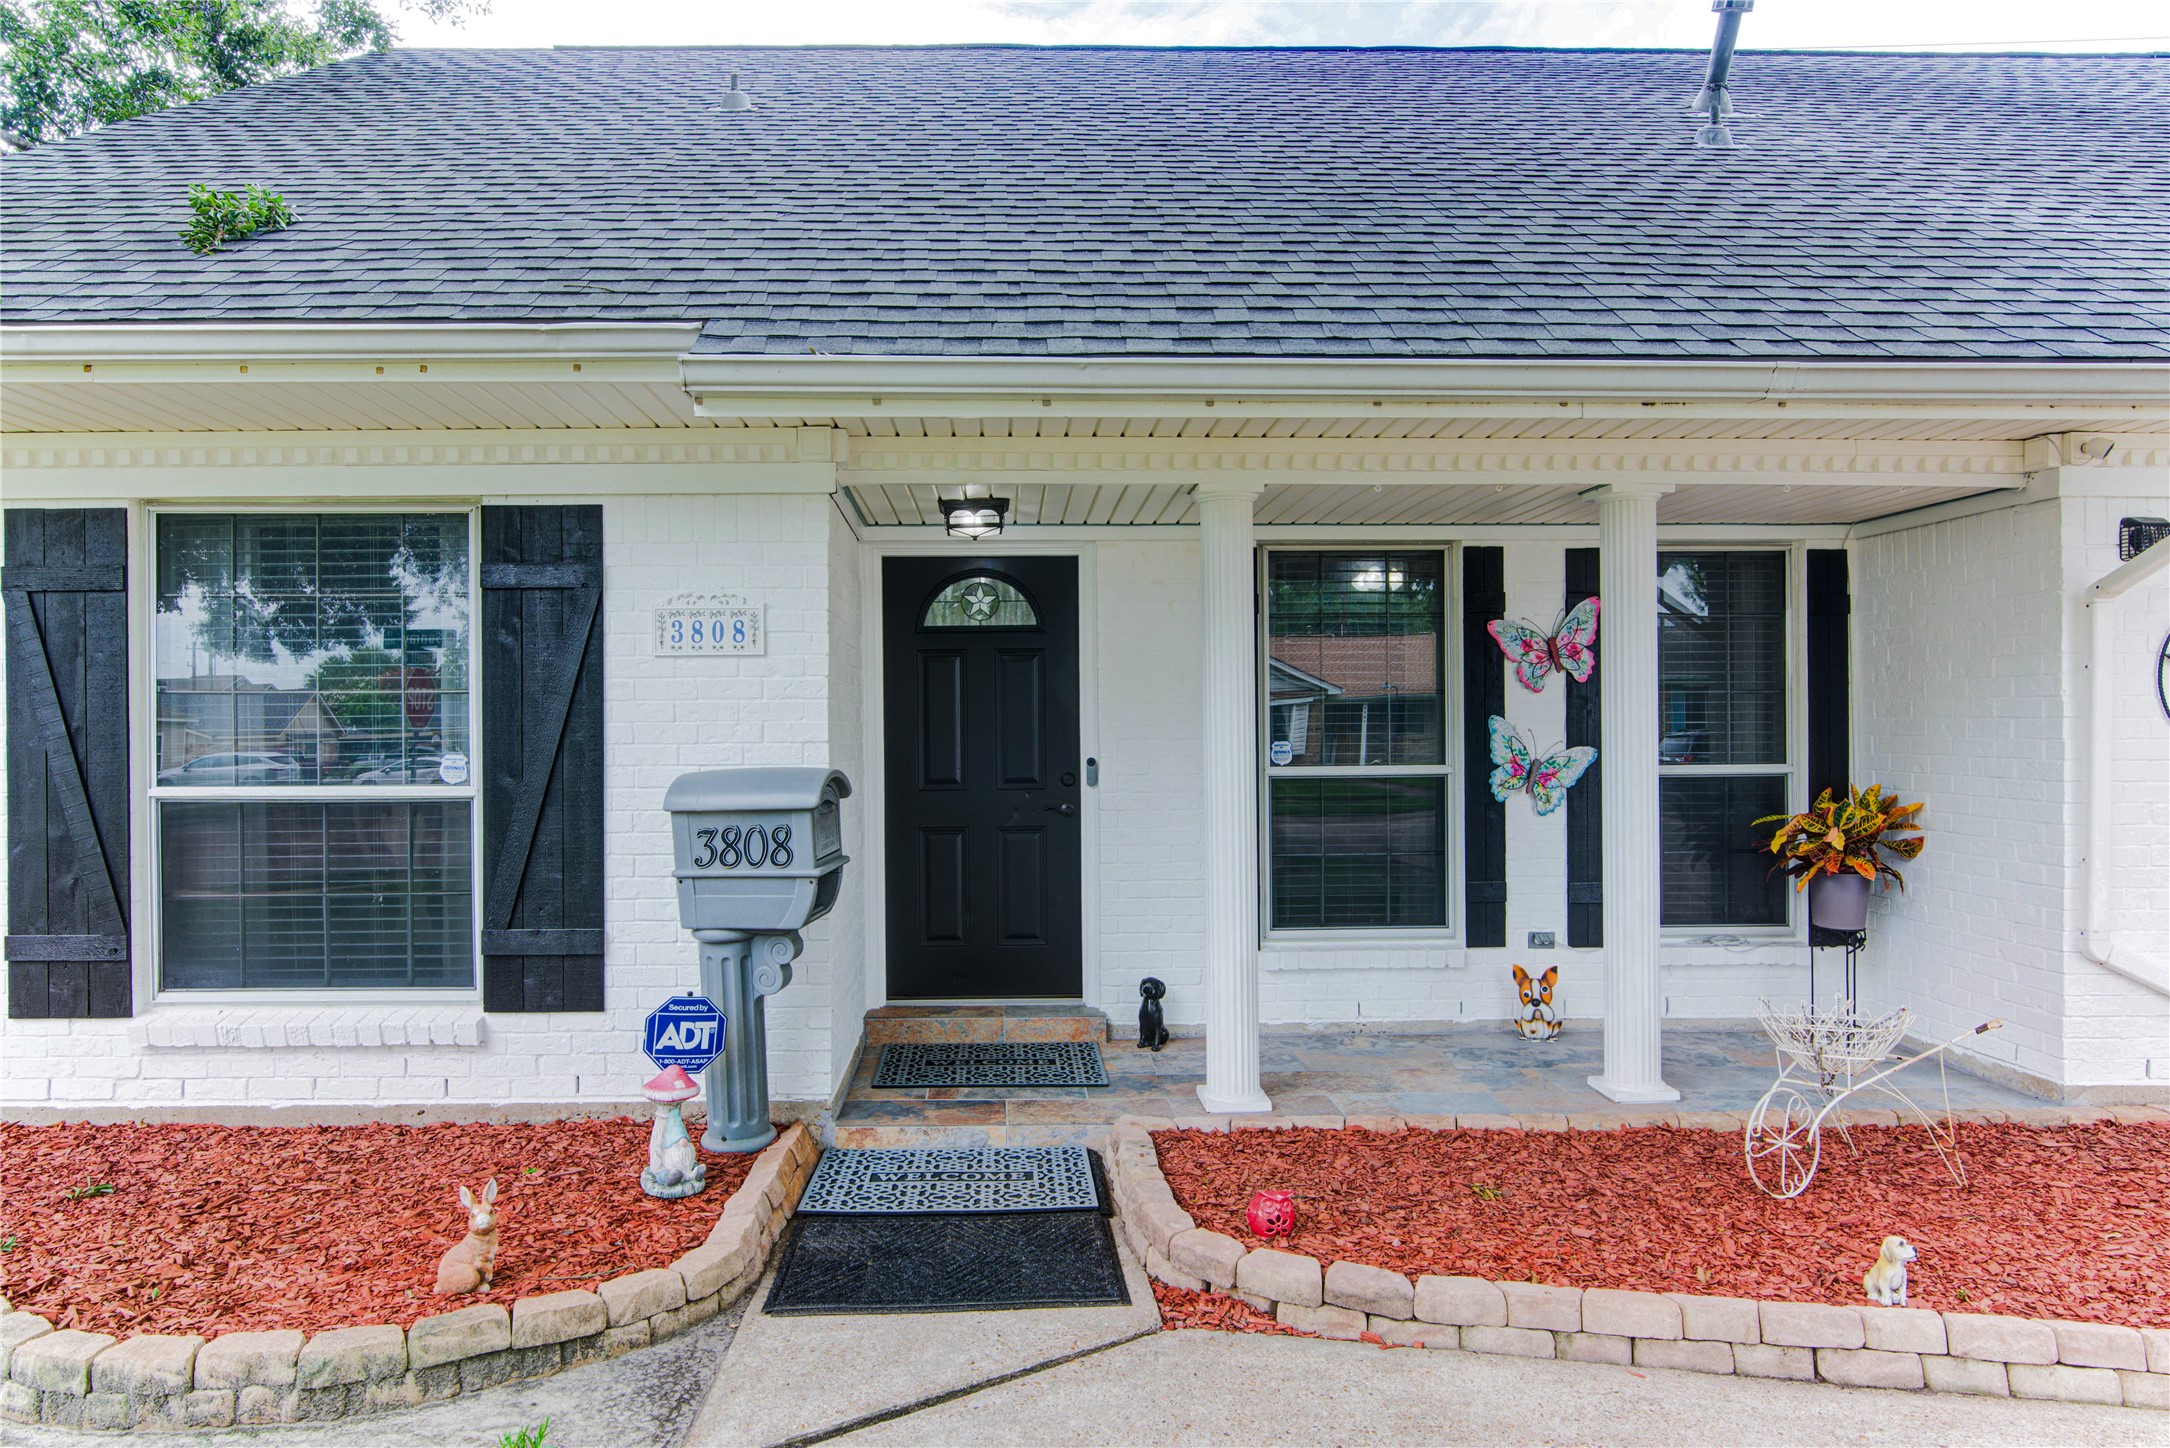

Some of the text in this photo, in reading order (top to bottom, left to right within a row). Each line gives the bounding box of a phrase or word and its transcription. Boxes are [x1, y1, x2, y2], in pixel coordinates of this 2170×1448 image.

[671, 620, 745, 643] 3808
[694, 824, 794, 869] 3808
[699, 1004, 708, 1012] by
[655, 1021, 717, 1050] ADT
[877, 1172, 1026, 1182] WELCOME
